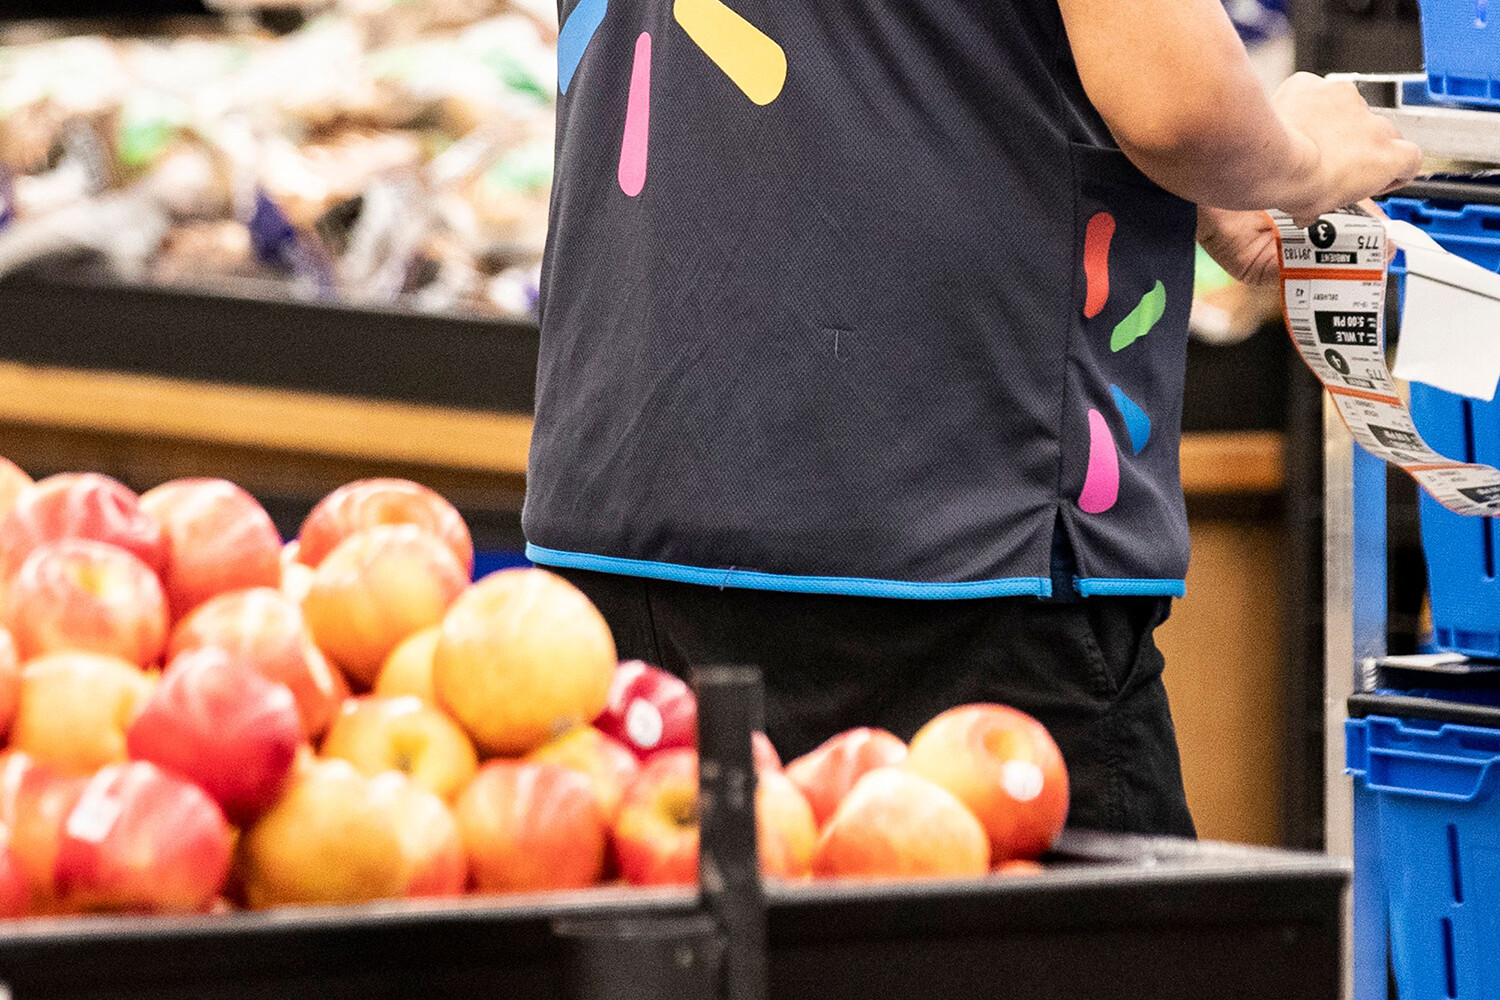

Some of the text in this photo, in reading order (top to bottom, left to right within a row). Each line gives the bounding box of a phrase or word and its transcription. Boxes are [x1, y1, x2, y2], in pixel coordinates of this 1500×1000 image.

[1316, 223, 1329, 241] 3
[1357, 234, 1379, 250] 775
[1319, 252, 1351, 263] AMBIENT
[1332, 316, 1365, 327] 5:00 PM
[1335, 331, 1357, 343] WILE
[1330, 354, 1343, 369] 4
[1365, 367, 1386, 381] 775
